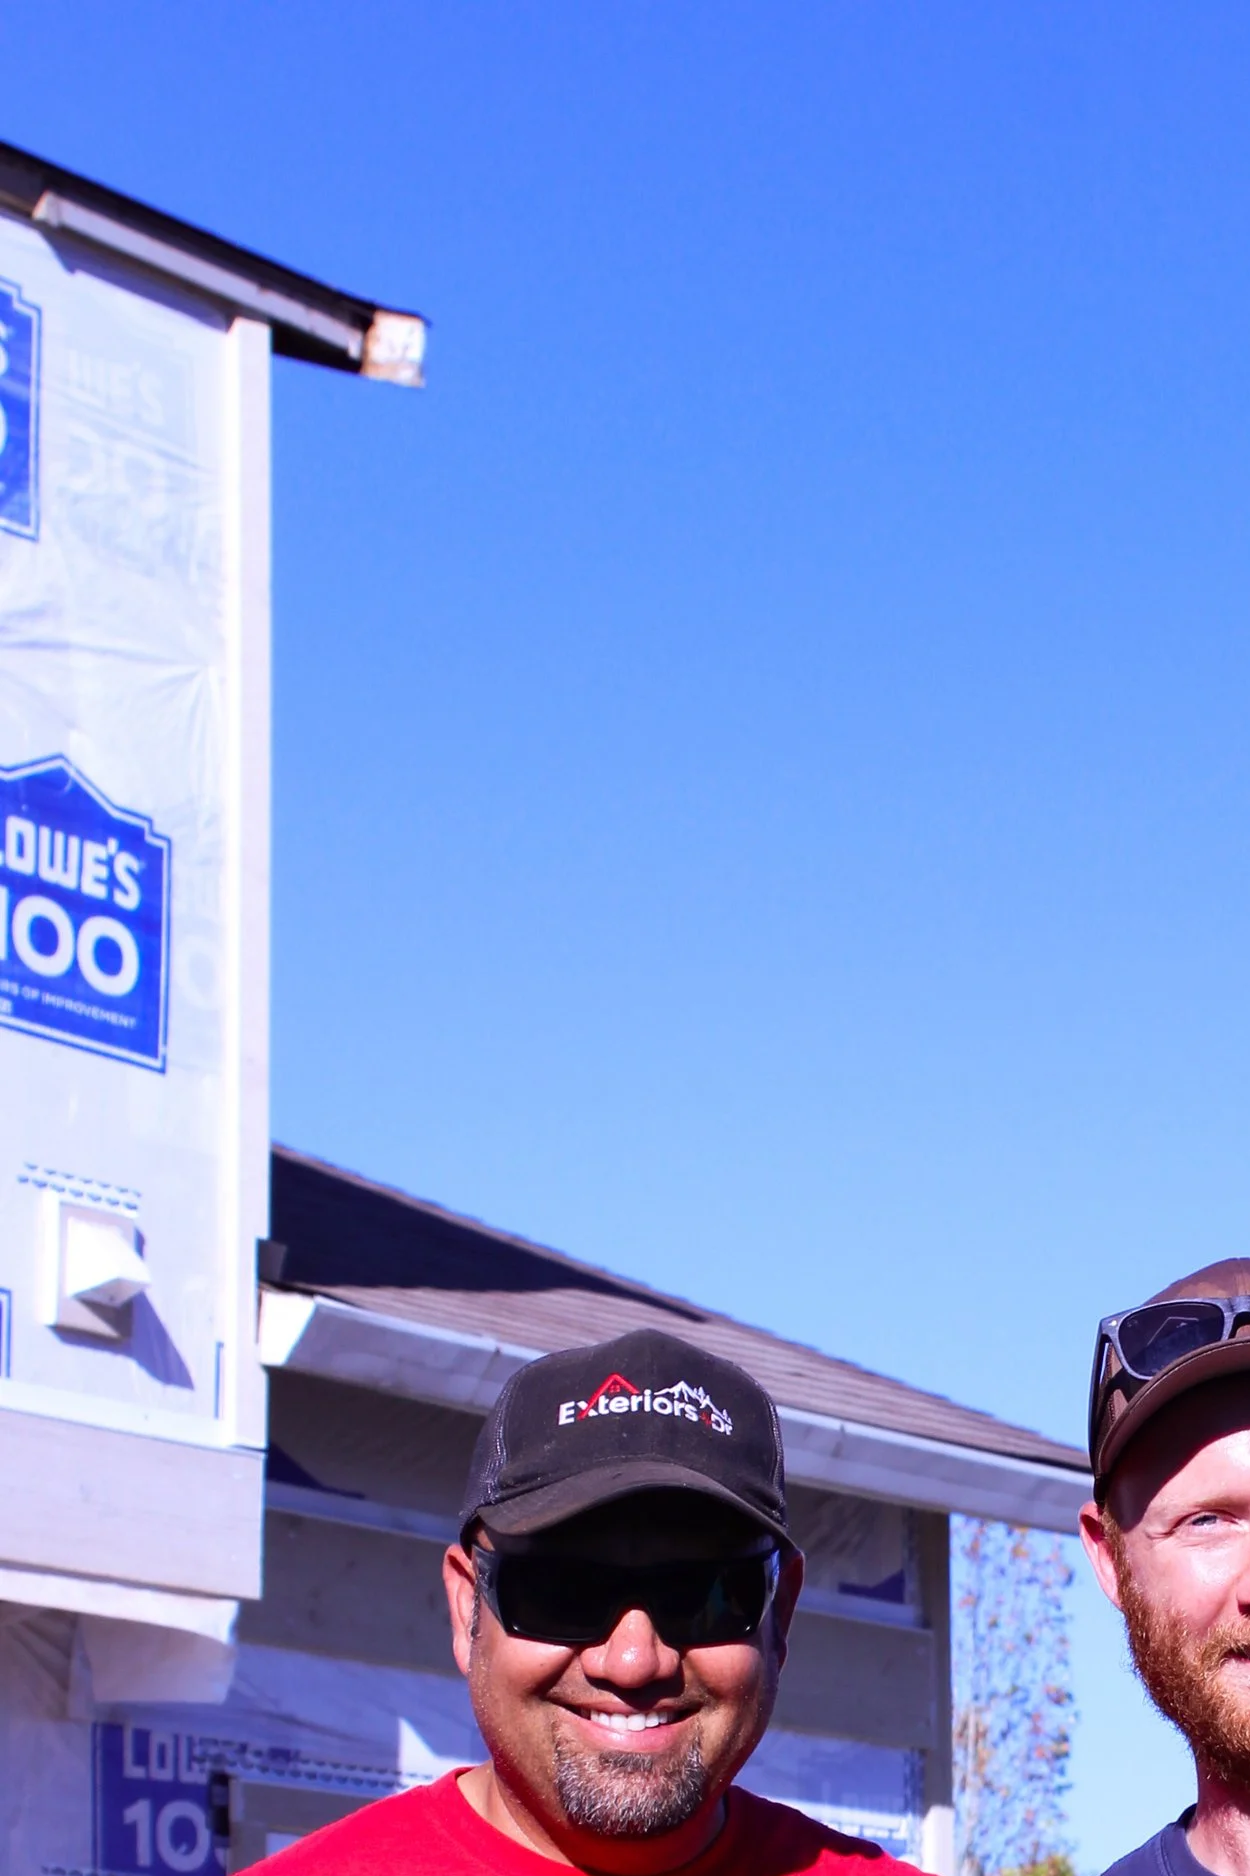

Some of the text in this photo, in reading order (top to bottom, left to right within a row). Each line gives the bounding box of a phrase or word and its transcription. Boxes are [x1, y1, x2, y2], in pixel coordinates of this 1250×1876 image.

[0, 815, 141, 911] OWE'S
[558, 1388, 698, 1426] Exteriors
[123, 1798, 229, 1871] 10
